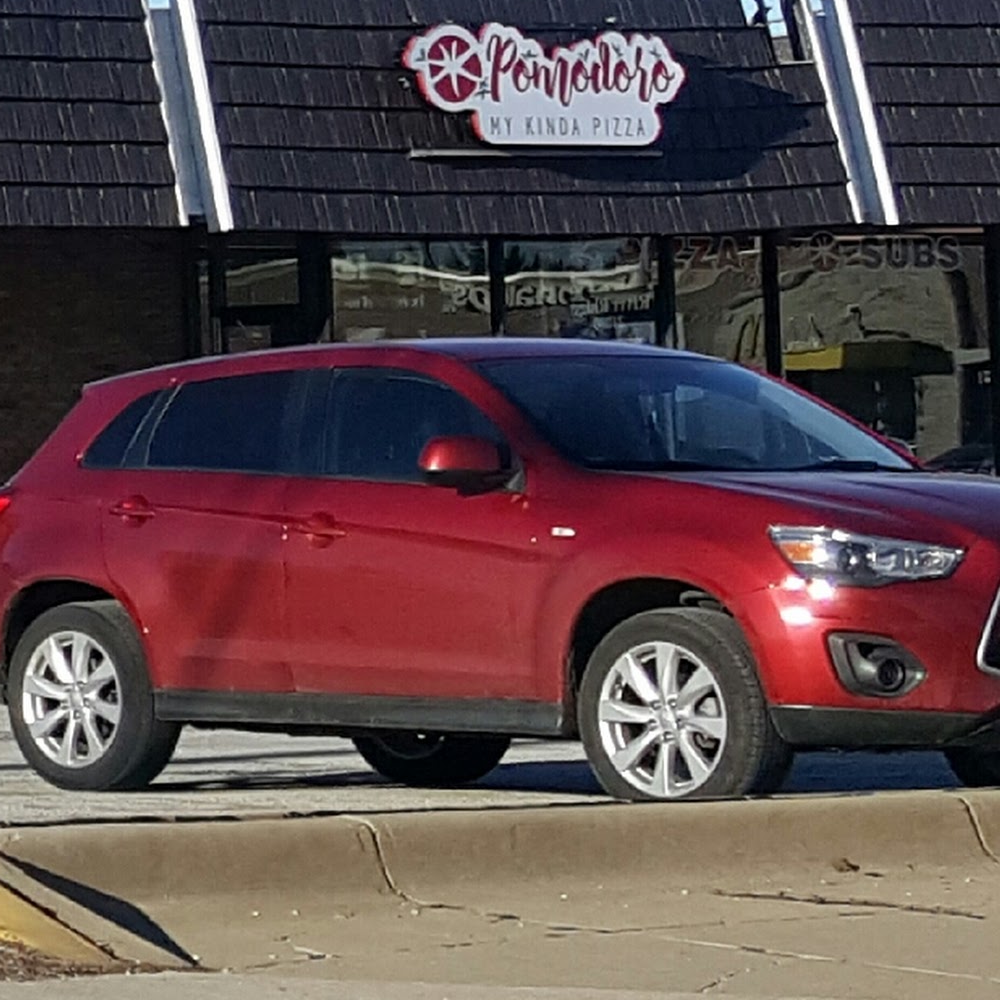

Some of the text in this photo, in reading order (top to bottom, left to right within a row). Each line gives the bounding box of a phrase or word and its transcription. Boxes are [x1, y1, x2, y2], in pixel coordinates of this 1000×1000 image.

[487, 34, 676, 107] Pomodoro
[490, 117, 646, 137] MY KINDA PIZZA
[860, 236, 962, 271] SUBS
